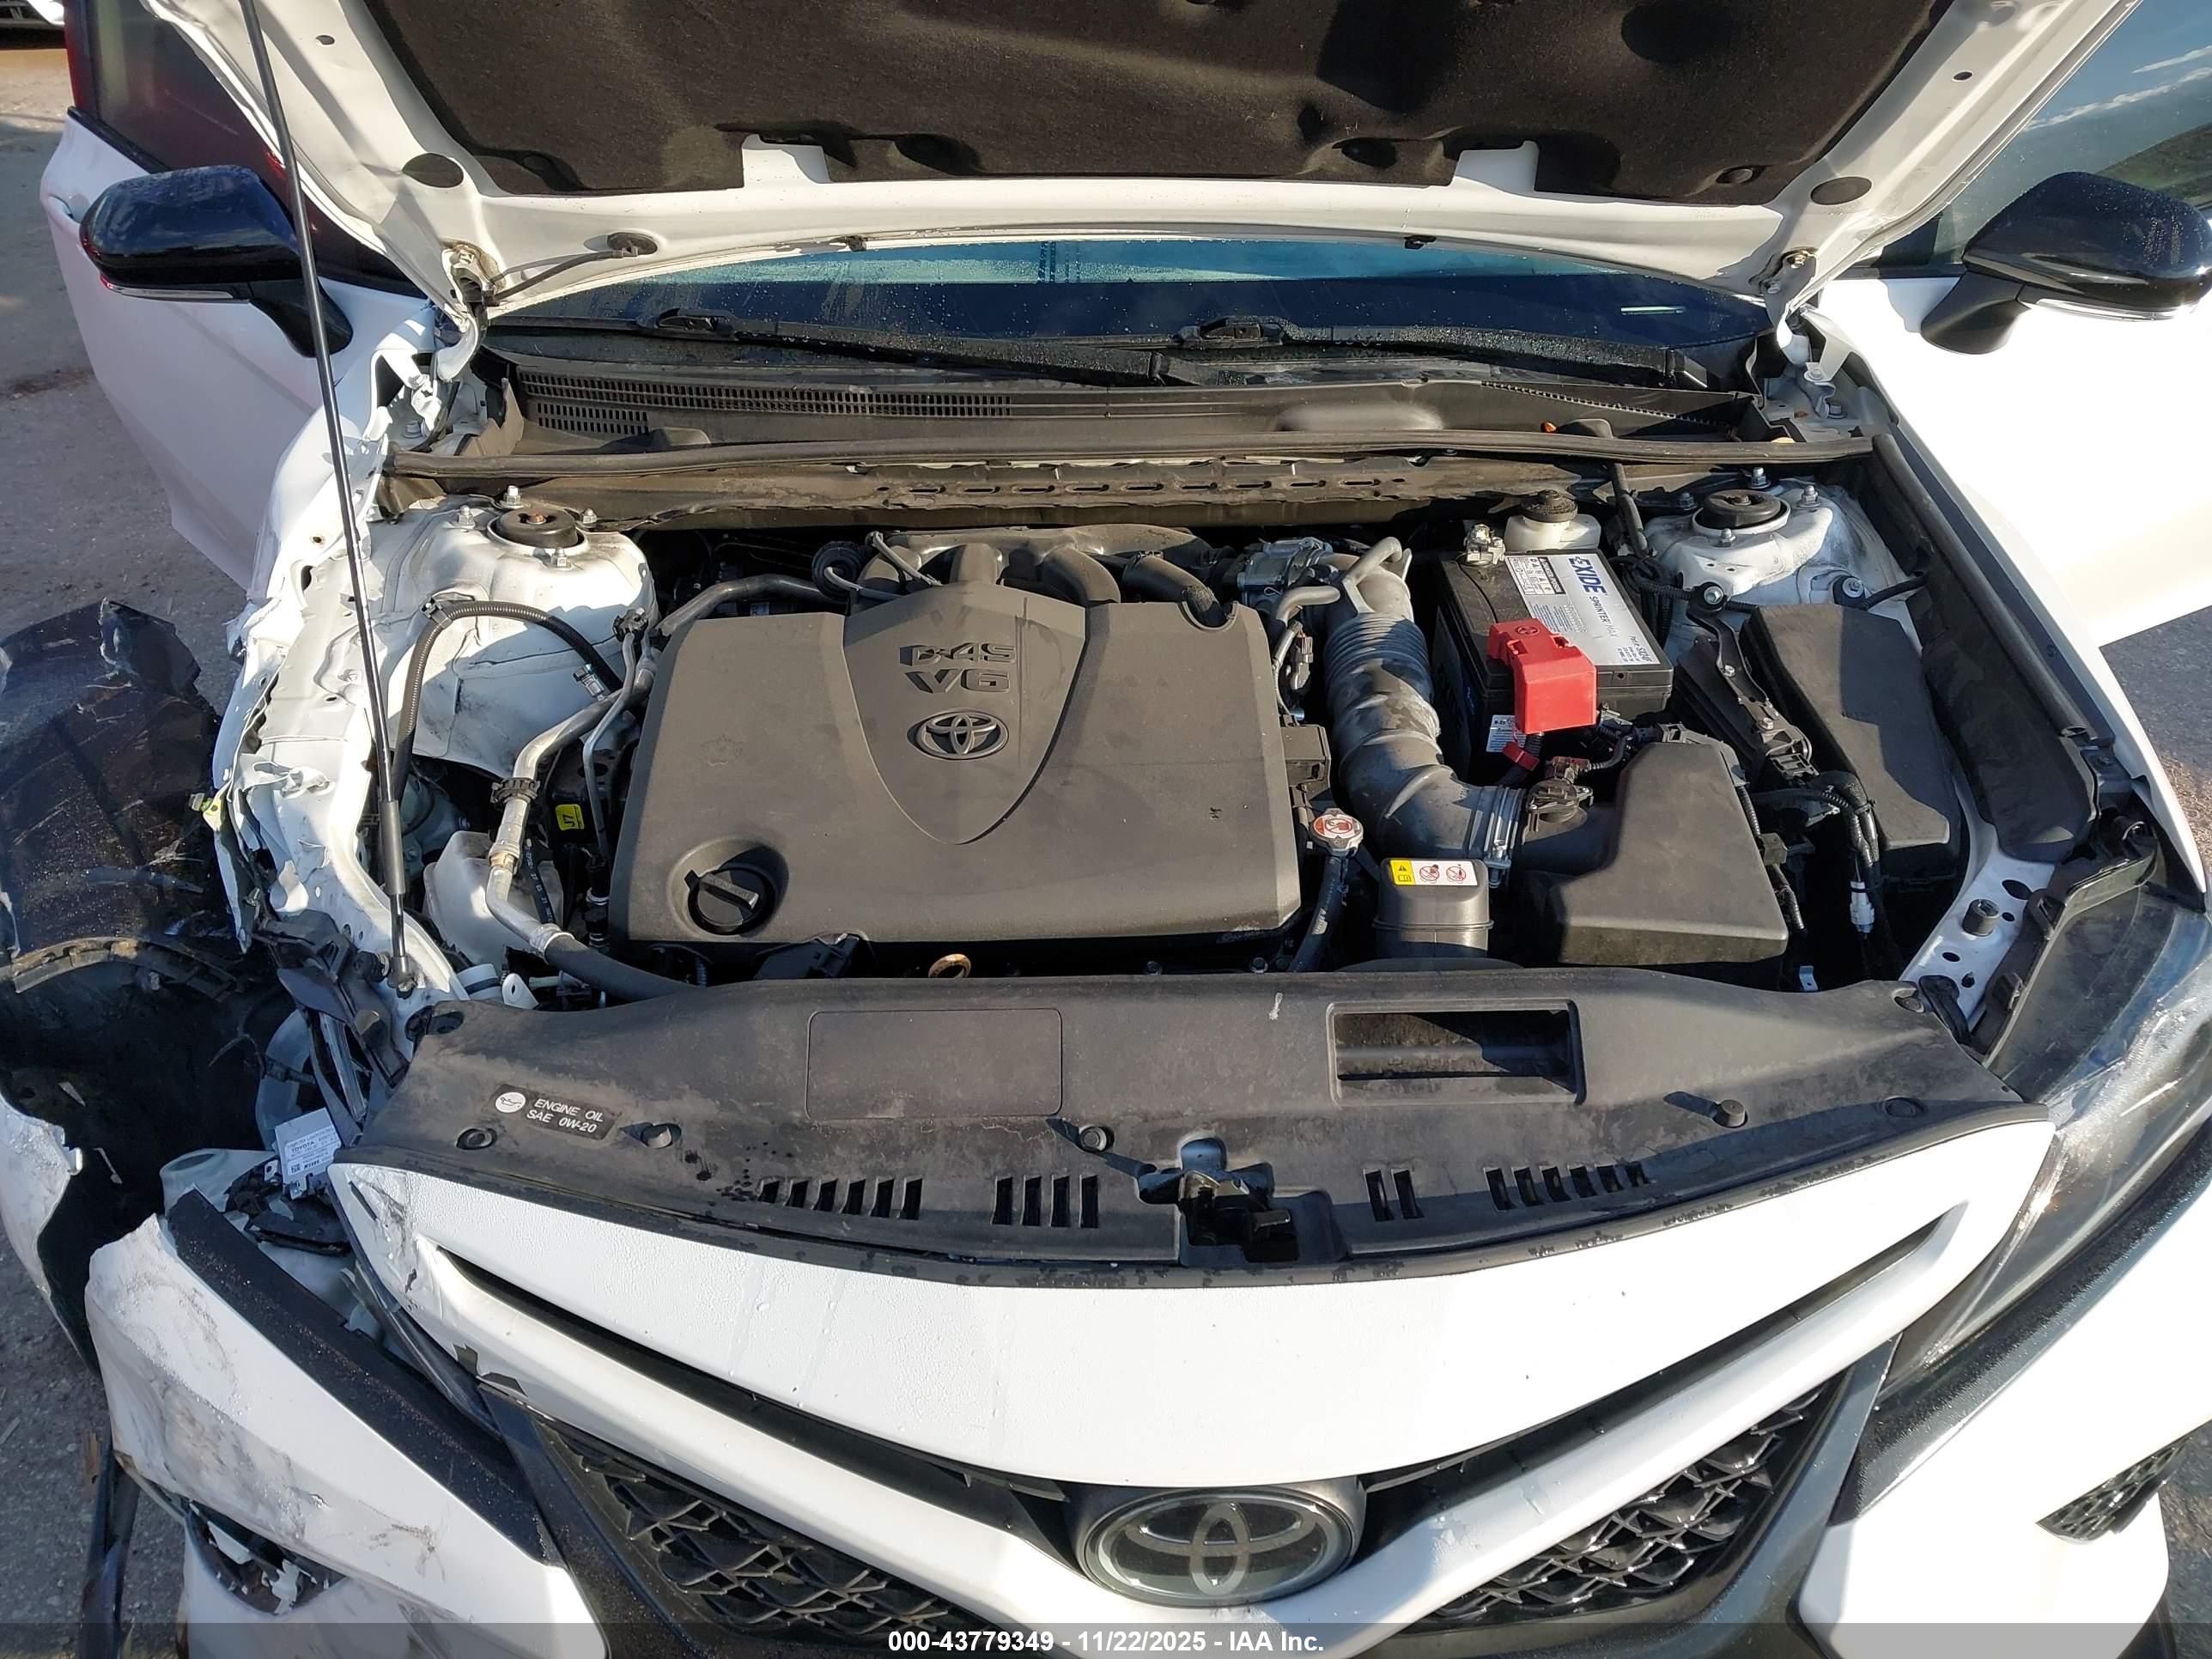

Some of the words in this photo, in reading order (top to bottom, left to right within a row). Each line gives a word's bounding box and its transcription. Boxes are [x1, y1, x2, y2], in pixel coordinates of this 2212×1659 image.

[1568, 556, 1607, 593] EXIDE
[1589, 596, 1611, 623] SPRINTER
[899, 642, 1016, 666] D-4S
[905, 669, 1011, 694] V6
[526, 1109, 555, 1123] SAE
[558, 1117, 598, 1133] 0W-20
[534, 1098, 580, 1116] ENGINE
[585, 1110, 604, 1122] OIL
[292, 1139, 315, 1153] TOYOTA
